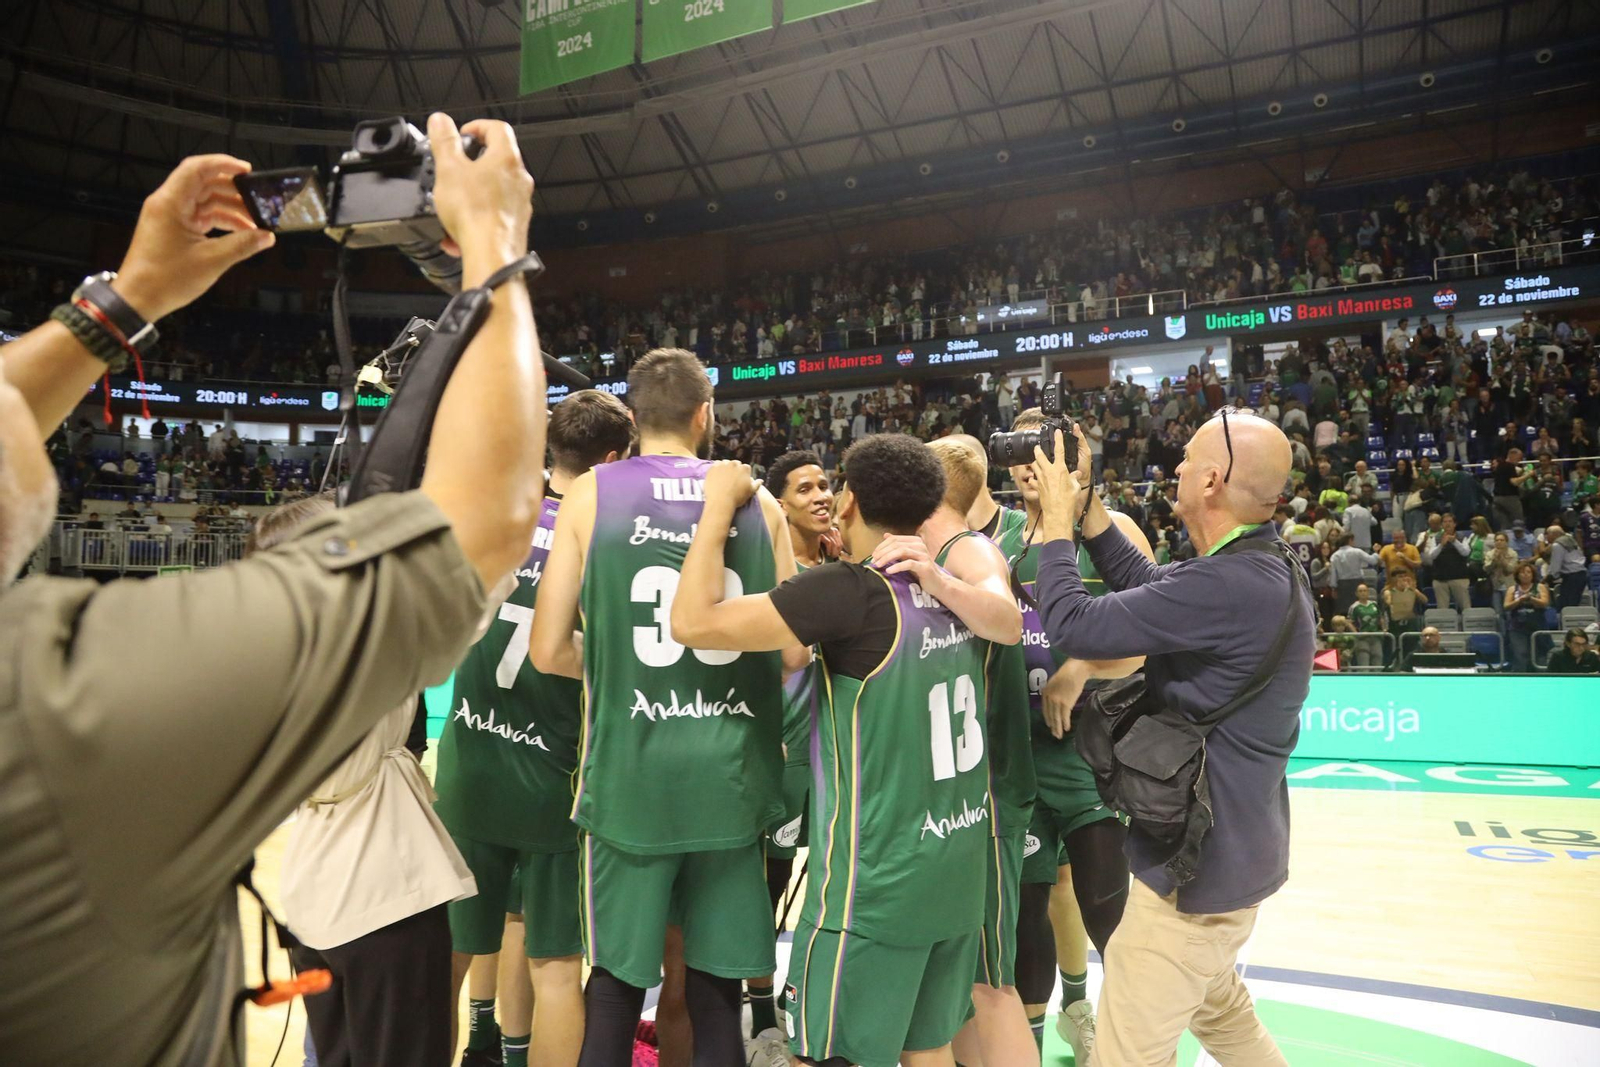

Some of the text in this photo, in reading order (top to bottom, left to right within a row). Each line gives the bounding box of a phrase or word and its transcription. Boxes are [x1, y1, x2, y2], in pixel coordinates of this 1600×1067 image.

[684, 0, 724, 22] 2024
[557, 31, 592, 57] 2024
[1504, 275, 1550, 290] Sábado
[1433, 293, 1457, 303] BAXI
[1479, 286, 1579, 306] 22 de noviembre
[1205, 310, 1265, 330] Unicaja
[1269, 305, 1292, 323] VS
[1297, 303, 1333, 319] Baxi
[1337, 296, 1413, 315] Manresa
[947, 339, 979, 351] Sábado
[1016, 332, 1073, 352] 20:00 H
[928, 348, 999, 364] 22 de noviembre
[732, 354, 883, 381] Unicaja VS Baxi Manresa
[111, 389, 124, 398] 22
[124, 390, 136, 399] de
[196, 389, 236, 404] 20:00
[356, 394, 391, 409] nicaj
[650, 477, 706, 502] TILLI
[1298, 543, 1310, 562] 8
[496, 602, 536, 690] 7
[630, 688, 755, 722] Andalucía
[453, 697, 551, 752] Andalcía
[929, 674, 984, 781] 13
[1299, 700, 1420, 742] nicaja
